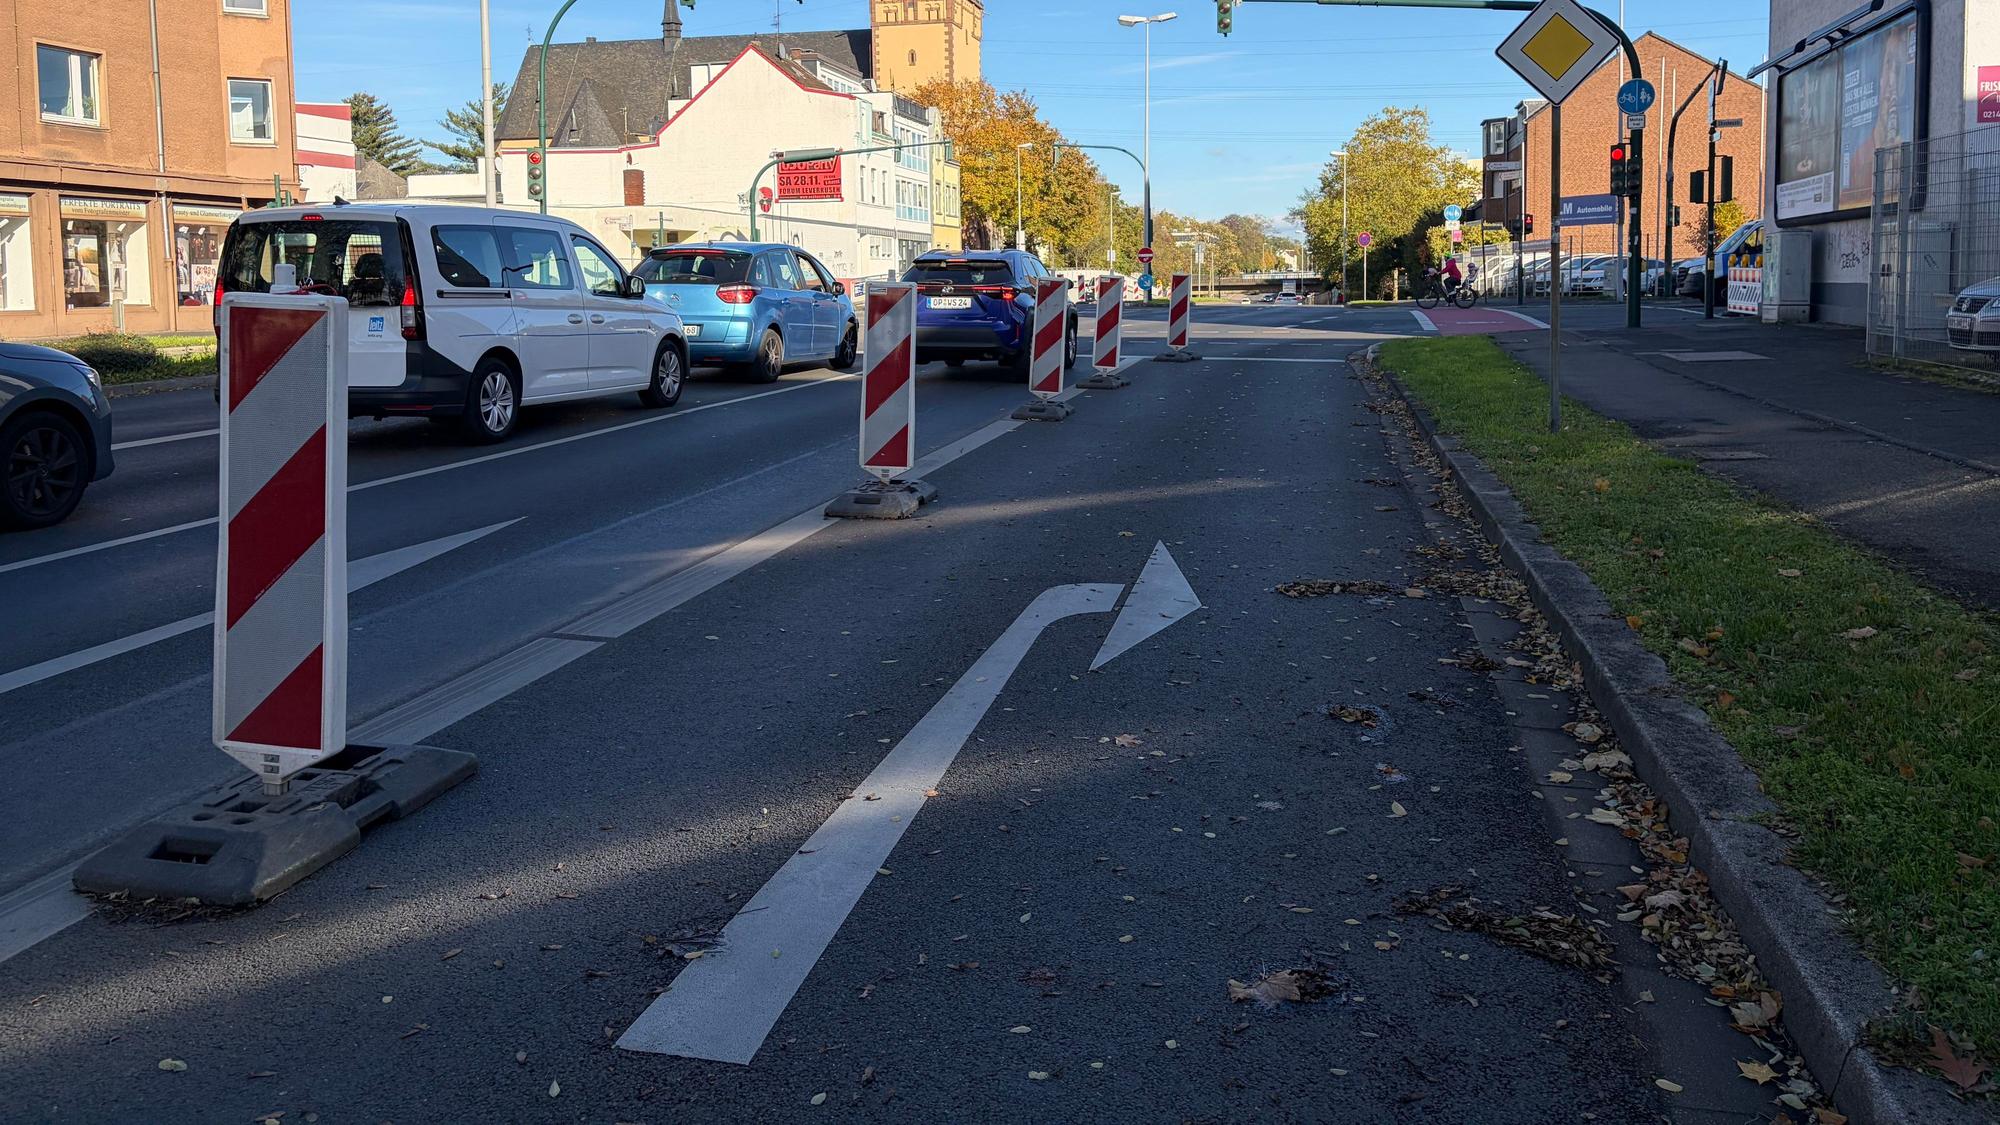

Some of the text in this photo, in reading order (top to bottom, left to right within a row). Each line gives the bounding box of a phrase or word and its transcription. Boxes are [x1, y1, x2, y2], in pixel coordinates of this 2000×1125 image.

[779, 177, 791, 186] SA
[793, 175, 821, 186] 28.11.
[1577, 205, 1613, 214] Automobile
